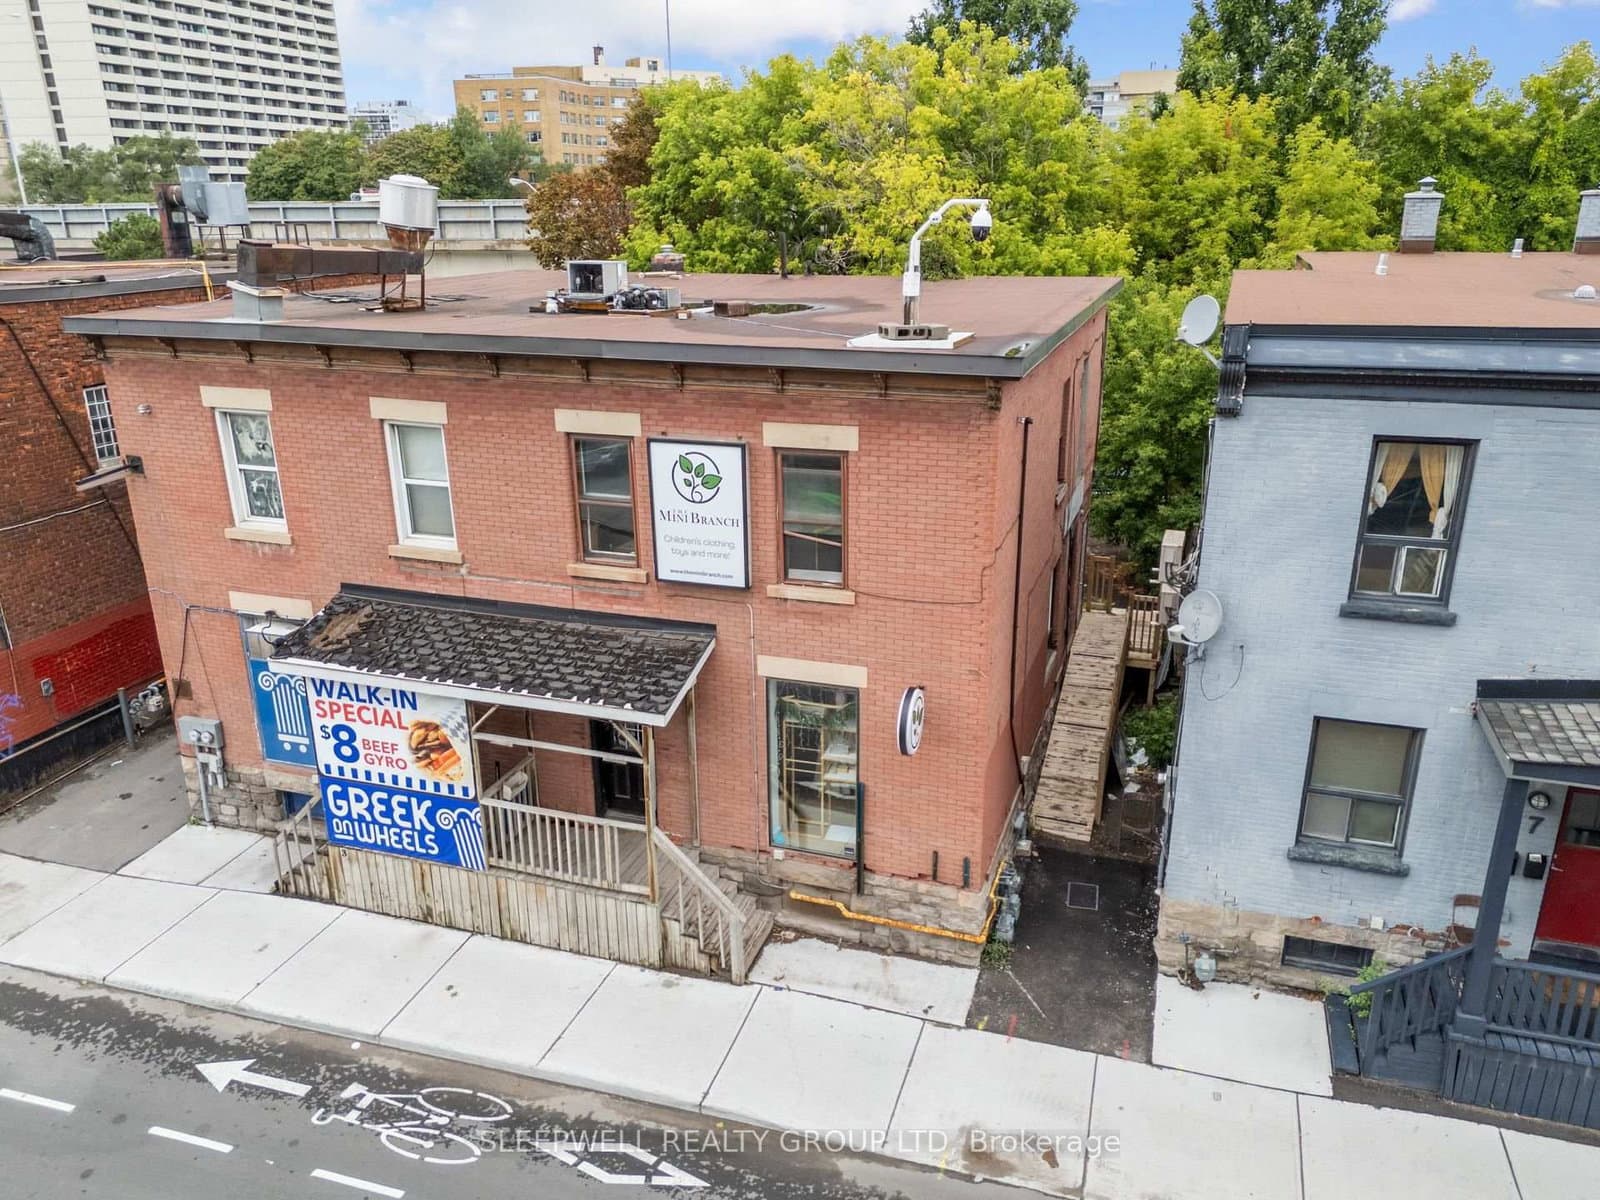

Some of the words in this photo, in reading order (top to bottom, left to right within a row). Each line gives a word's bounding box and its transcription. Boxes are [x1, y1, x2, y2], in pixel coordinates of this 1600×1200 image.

[691, 511, 740, 528] BRANCH
[690, 549, 706, 558] and
[311, 677, 418, 711] WALK-IN
[315, 699, 409, 730] SPECIAL
[362, 738, 399, 755] BEEF
[364, 753, 408, 770] GYRO
[327, 784, 436, 833] GREEK
[1528, 815, 1546, 835] 7
[354, 820, 440, 855] WHEELS
